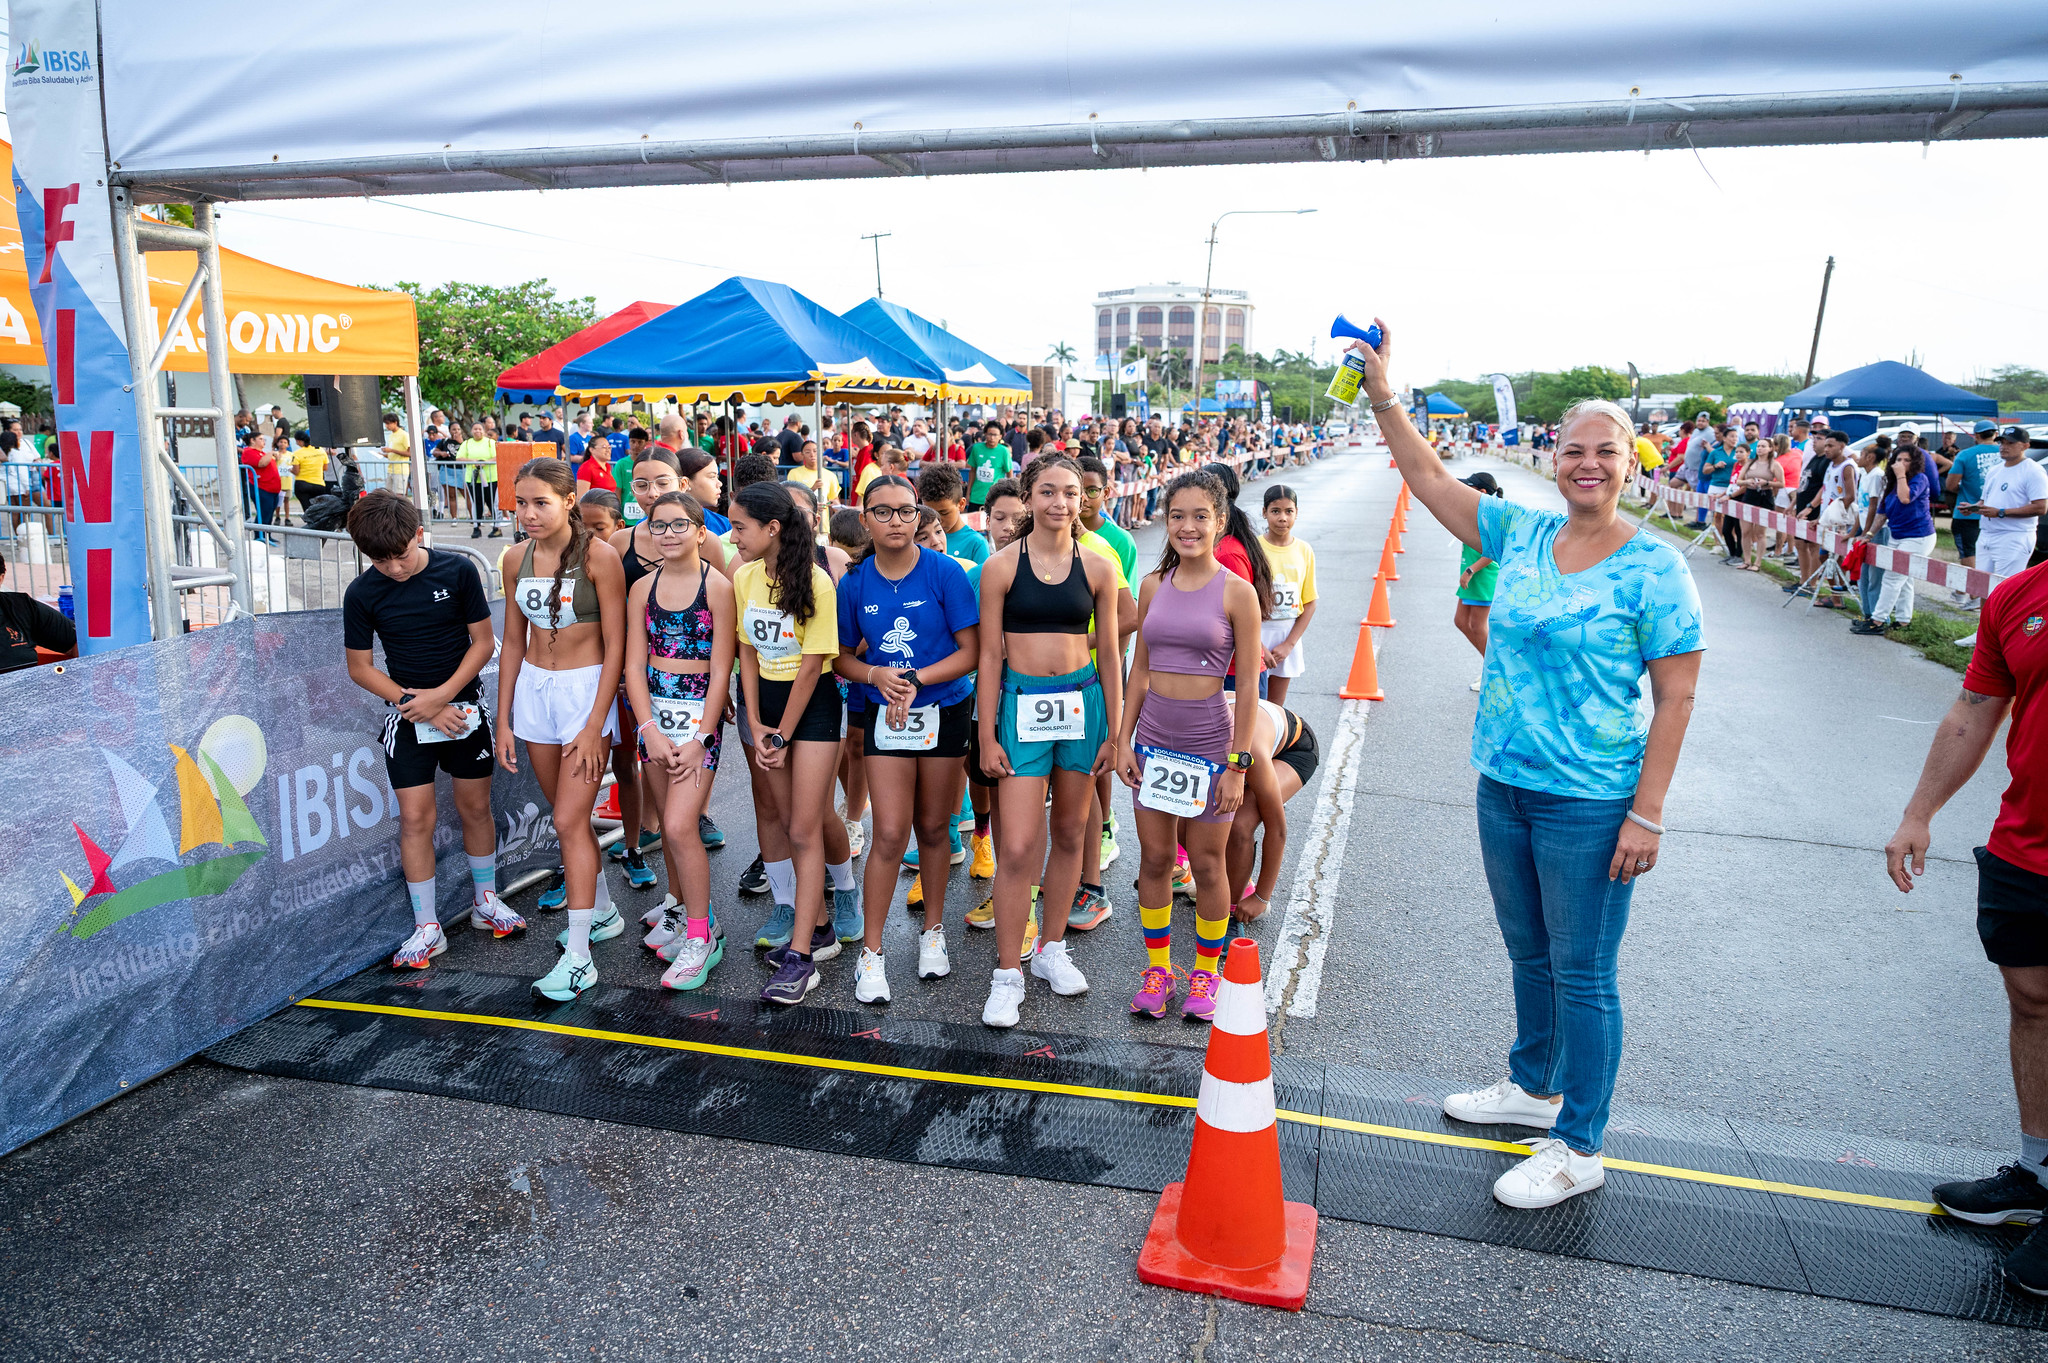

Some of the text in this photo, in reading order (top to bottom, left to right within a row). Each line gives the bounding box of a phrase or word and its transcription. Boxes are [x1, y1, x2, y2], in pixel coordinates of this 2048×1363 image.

[29, 77, 40, 85] Biba
[41, 76, 75, 84] Saludabel
[864, 604, 879, 614] 100
[753, 619, 782, 644] 87
[755, 643, 788, 651] SCHOOLSPORT
[1034, 699, 1065, 723] 91
[659, 709, 691, 730] 82
[1029, 724, 1073, 732] SCHOOLSPORT
[1150, 766, 1201, 799] 291
[1151, 792, 1194, 808] SCHOOLSPORT
